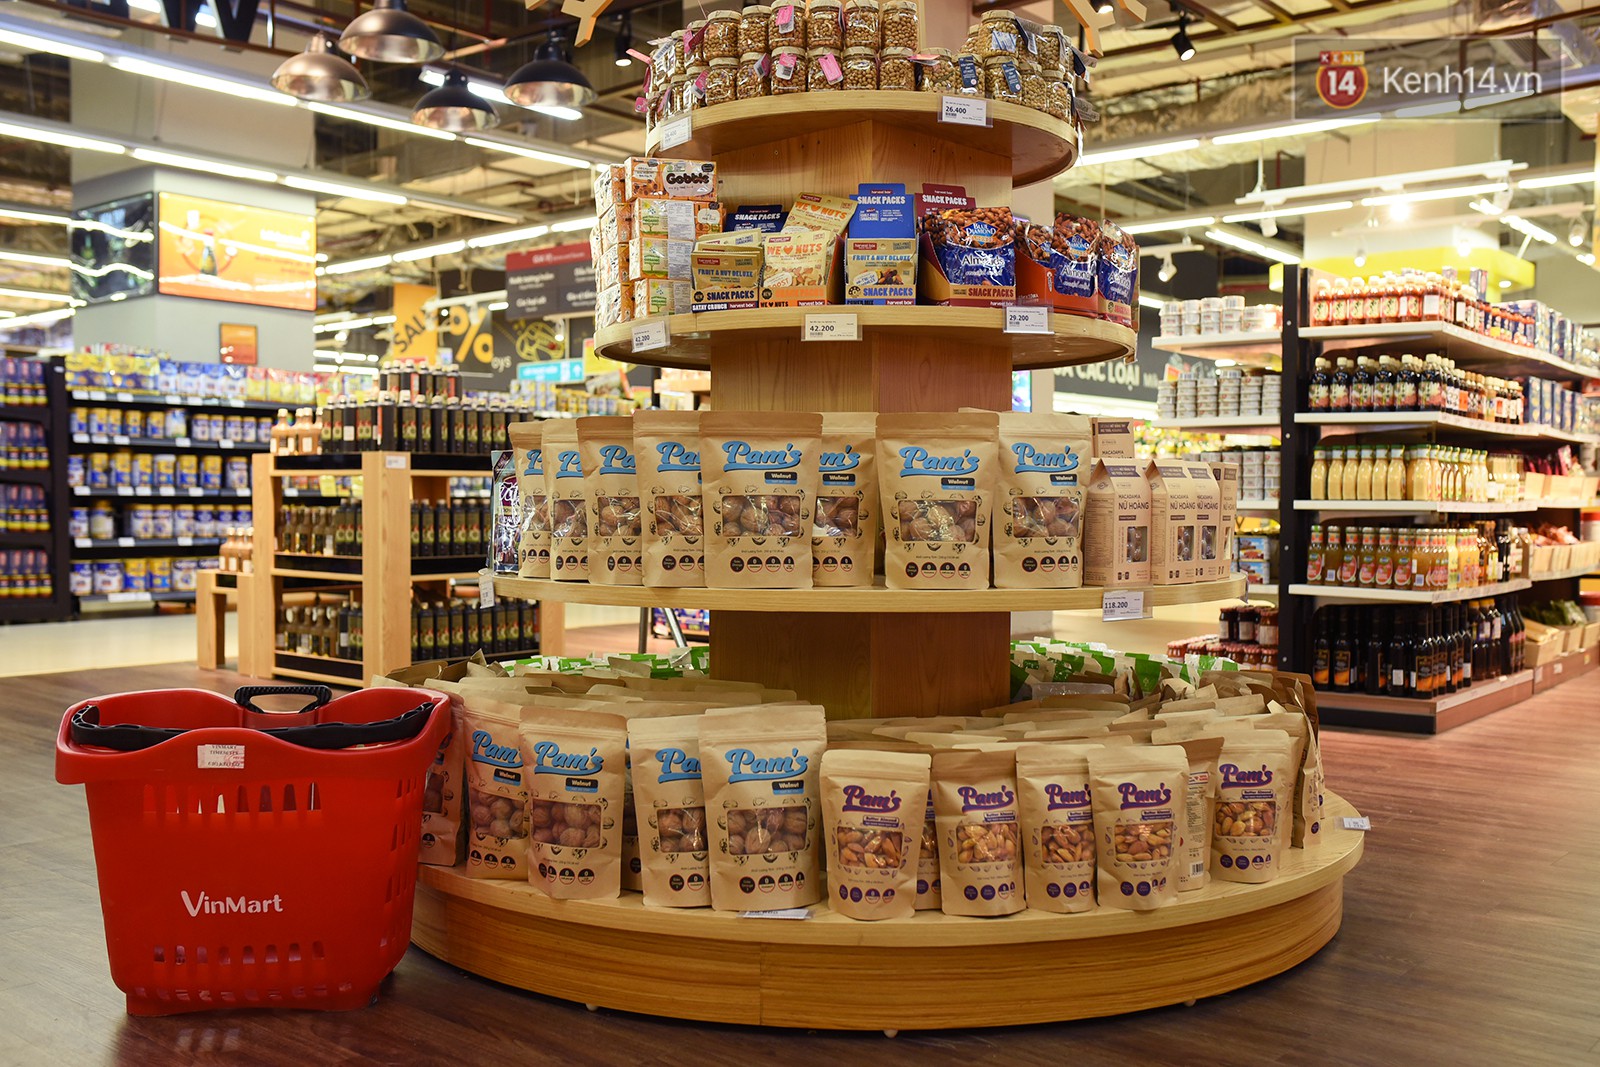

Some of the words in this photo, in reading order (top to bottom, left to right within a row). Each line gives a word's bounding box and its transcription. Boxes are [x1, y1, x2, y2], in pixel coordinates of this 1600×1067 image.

[945, 105, 967, 114] 26.400
[857, 196, 881, 205] SNACK
[882, 196, 906, 205] PACKS
[922, 194, 945, 204] SNACK
[945, 197, 967, 206] PACKS
[734, 213, 758, 221] SNACK
[759, 212, 781, 220] PACKS
[821, 207, 847, 220] NUTS
[767, 246, 782, 255] WE
[795, 243, 823, 254] NUTS
[707, 291, 730, 301] SNACK
[731, 290, 755, 300] PACKS
[863, 287, 888, 297] SNACK
[889, 287, 913, 297] PACKS
[968, 287, 992, 297] SNACK
[992, 288, 1014, 298] PACKS
[1009, 314, 1029, 322] 29.200
[393, 310, 428, 353] SAL
[722, 440, 803, 465] Pam's
[899, 446, 980, 471] Pam's
[1011, 442, 1079, 467] Pam's
[1104, 601, 1129, 609] 118.200
[534, 741, 605, 770] Pam's
[725, 747, 809, 774] Pam's
[1219, 763, 1274, 784] Pam's
[571, 779, 592, 787] Walnut
[842, 785, 902, 810] Pam's
[957, 784, 1015, 808] Pam's
[1117, 782, 1172, 804] Pam's
[181, 890, 284, 917] VinMart
